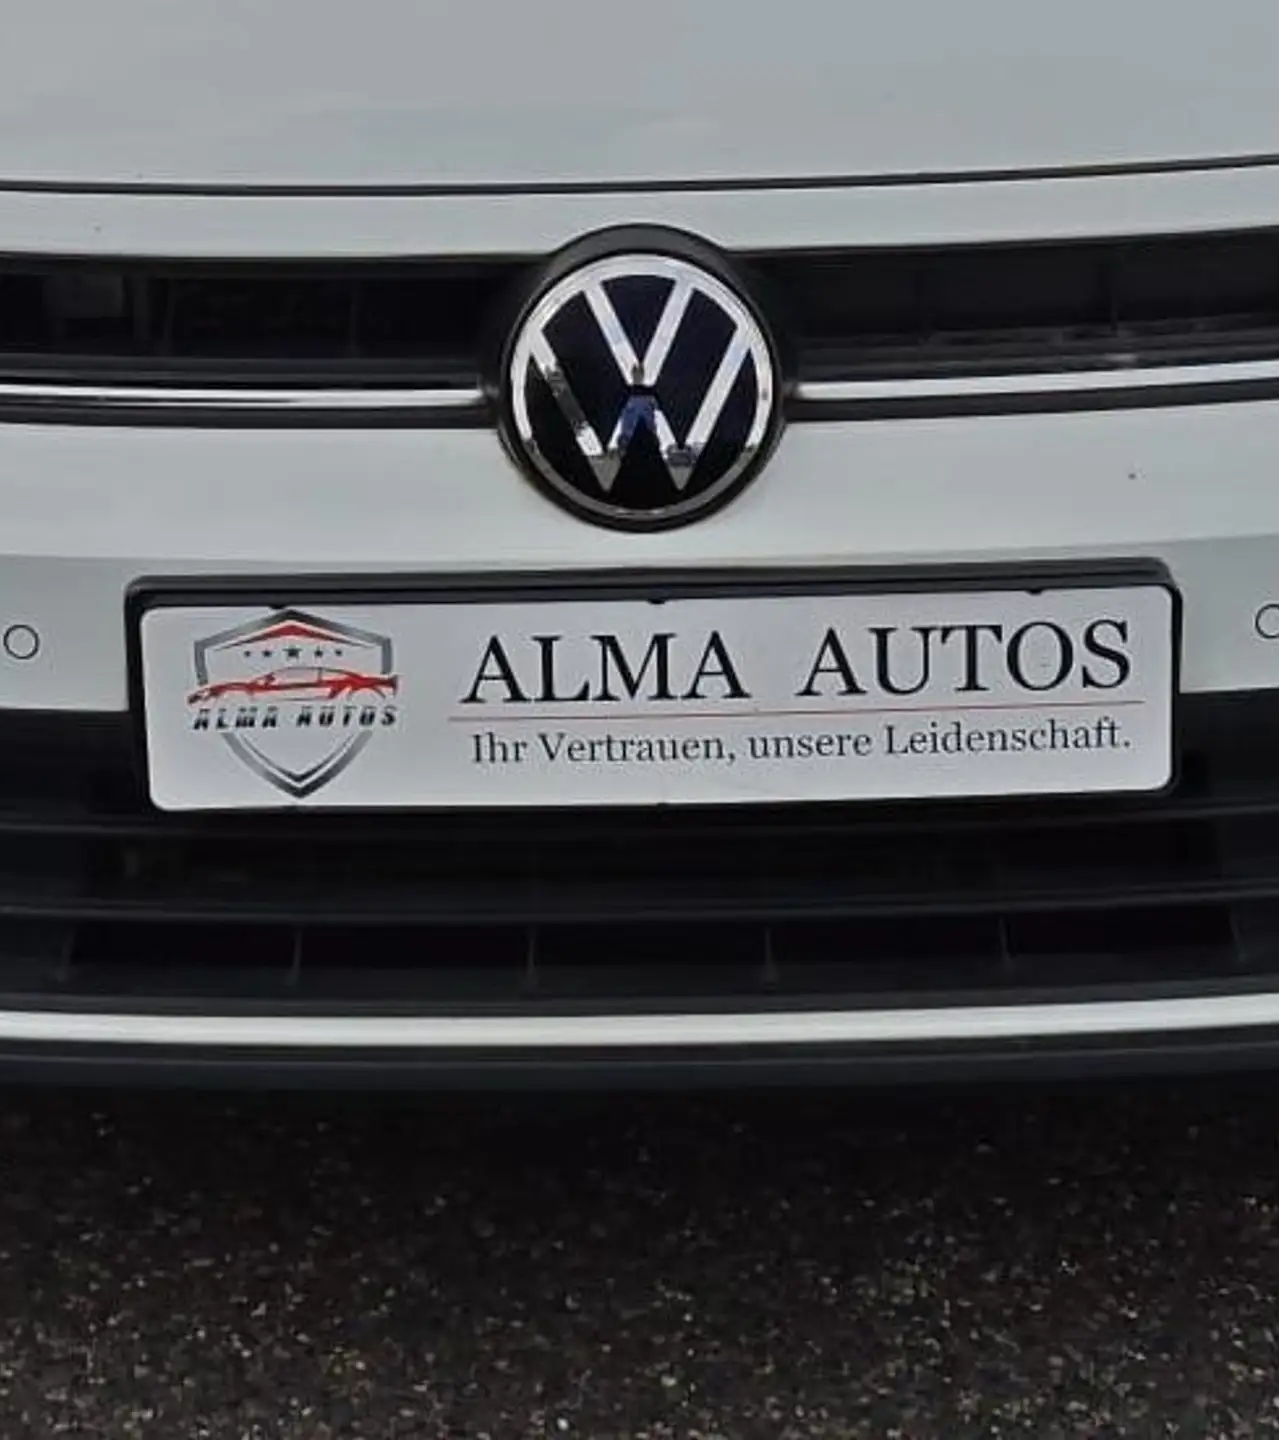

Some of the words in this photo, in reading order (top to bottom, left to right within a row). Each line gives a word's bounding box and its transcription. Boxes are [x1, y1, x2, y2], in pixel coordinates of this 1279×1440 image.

[526, 268, 754, 492] VW
[460, 631, 751, 703] ALMA
[796, 620, 1130, 696] AUTOS
[193, 706, 278, 730] ALMA
[296, 705, 397, 726] AUTOS
[472, 732, 528, 763] Ihr
[538, 731, 736, 763] Vertrauen,
[749, 733, 871, 759] unsere
[885, 716, 1130, 755] Leidenschaft.
